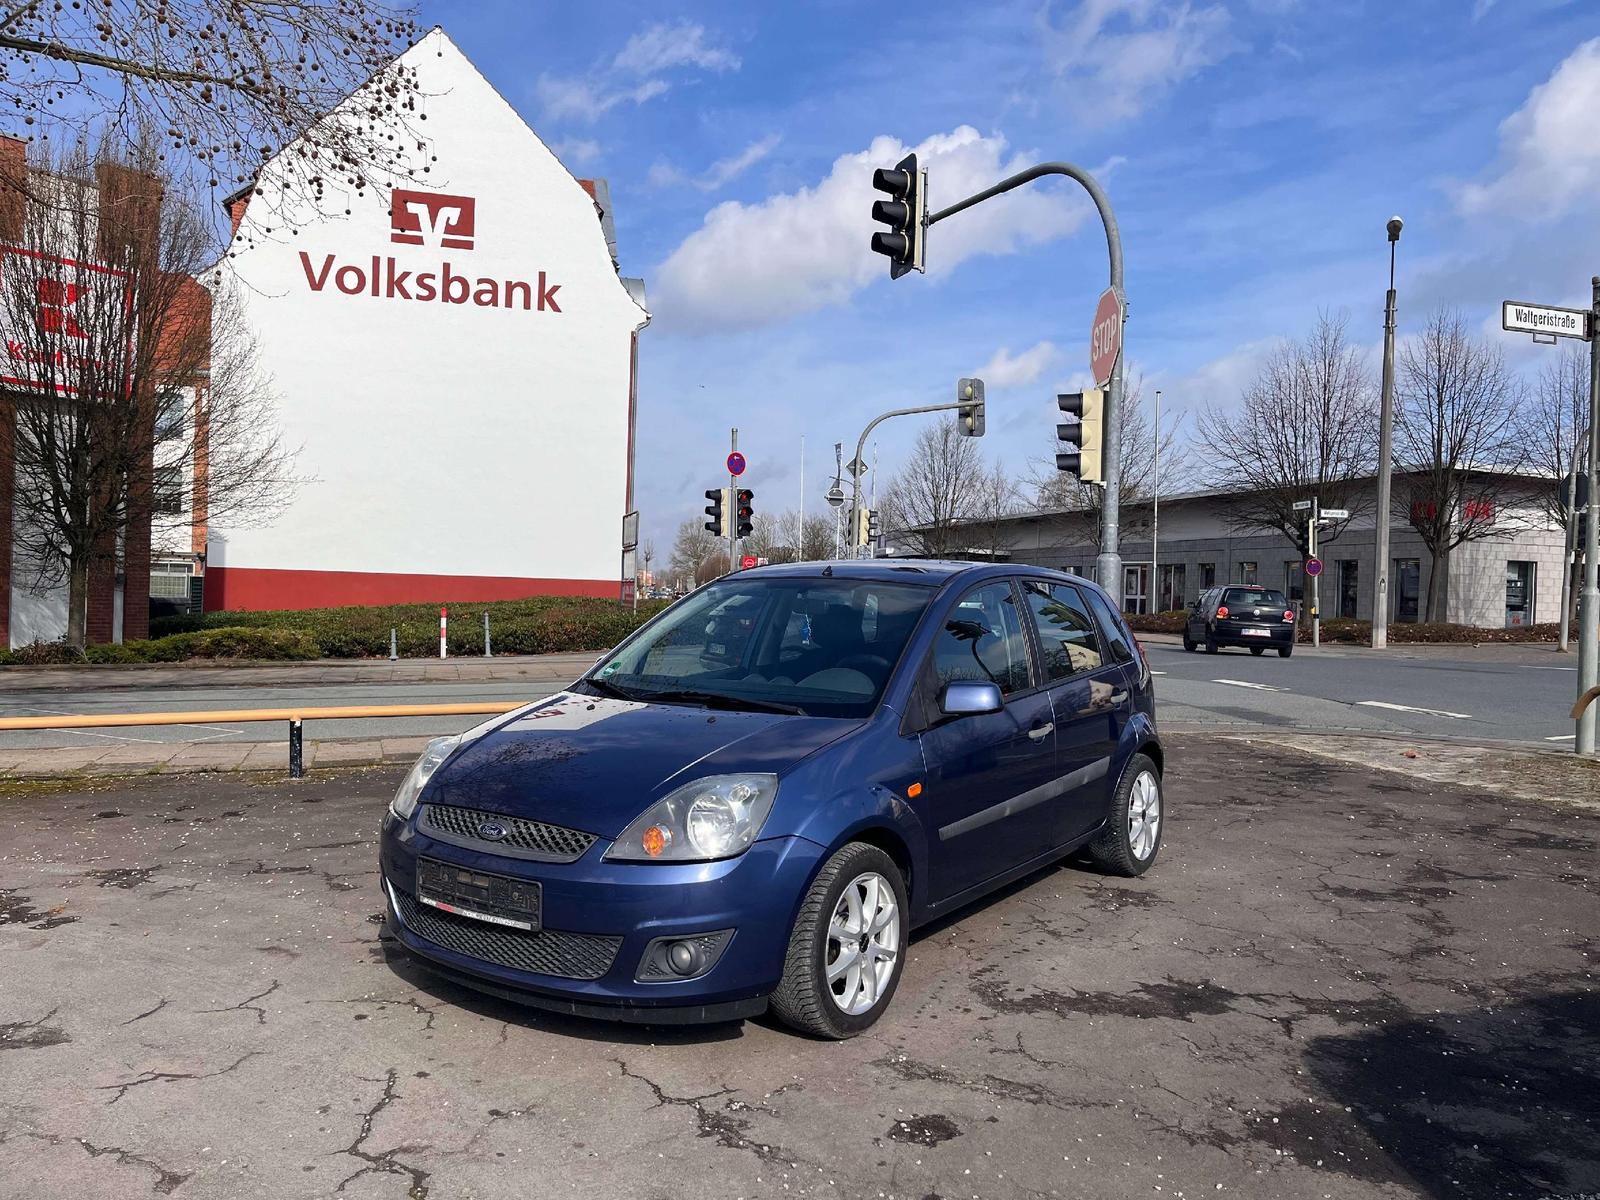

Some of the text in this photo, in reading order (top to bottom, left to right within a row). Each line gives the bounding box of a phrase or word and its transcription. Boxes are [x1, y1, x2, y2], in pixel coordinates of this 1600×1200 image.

[299, 251, 562, 313] Volksbank
[1092, 313, 1117, 362] STOP
[1515, 308, 1576, 329] Waltgeristraße
